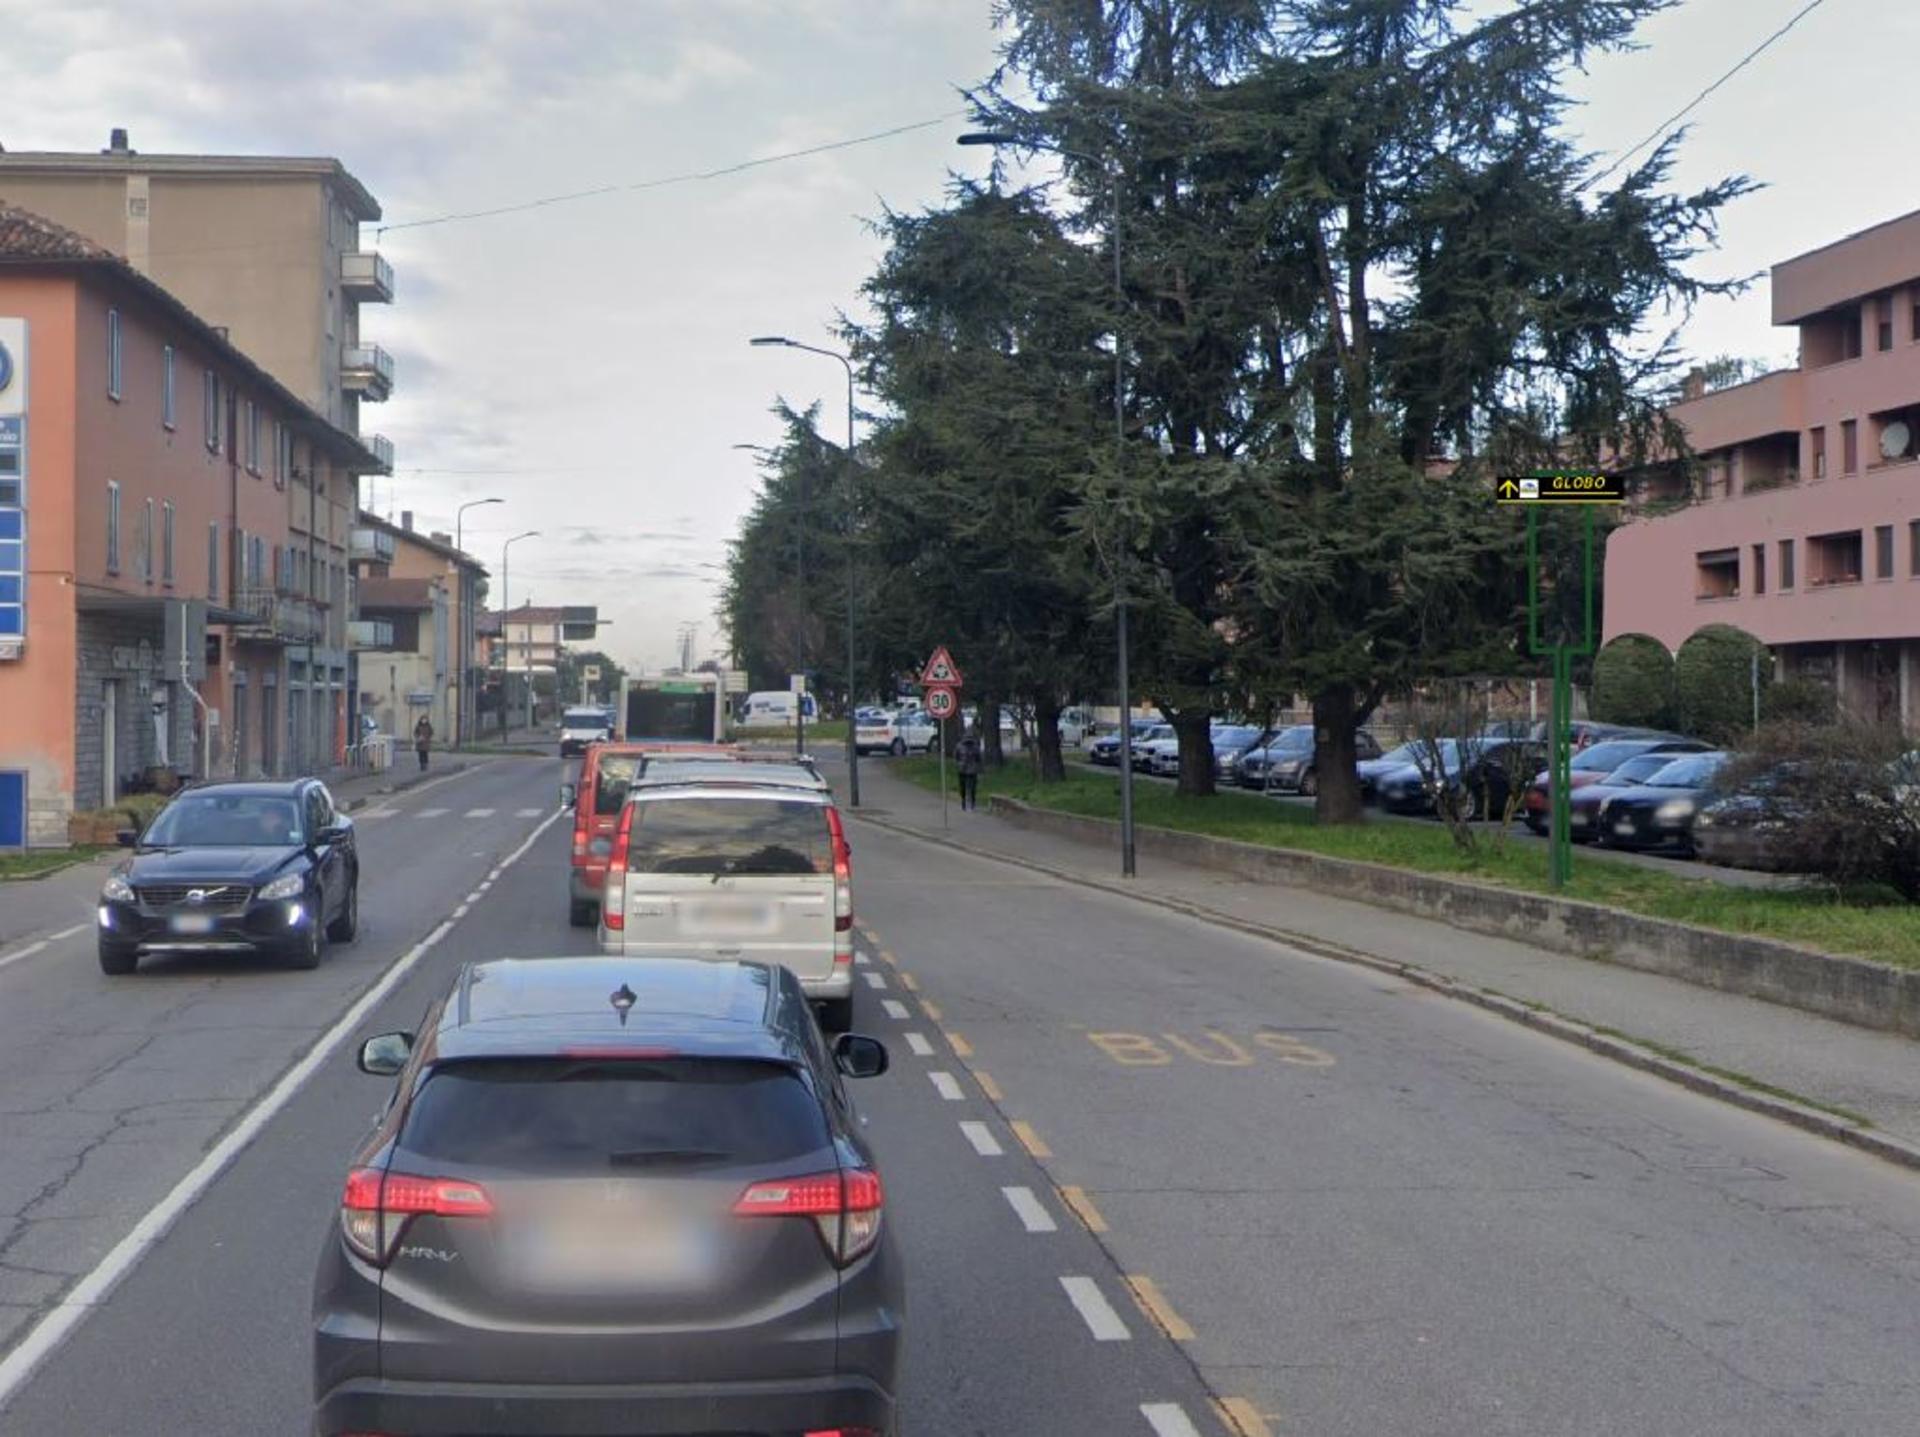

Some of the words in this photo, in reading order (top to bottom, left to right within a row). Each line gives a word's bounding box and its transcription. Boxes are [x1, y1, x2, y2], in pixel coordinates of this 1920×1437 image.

[1552, 476, 1606, 489] GLOBO
[931, 694, 950, 709] 30
[1086, 1031, 1337, 1066] BUS
